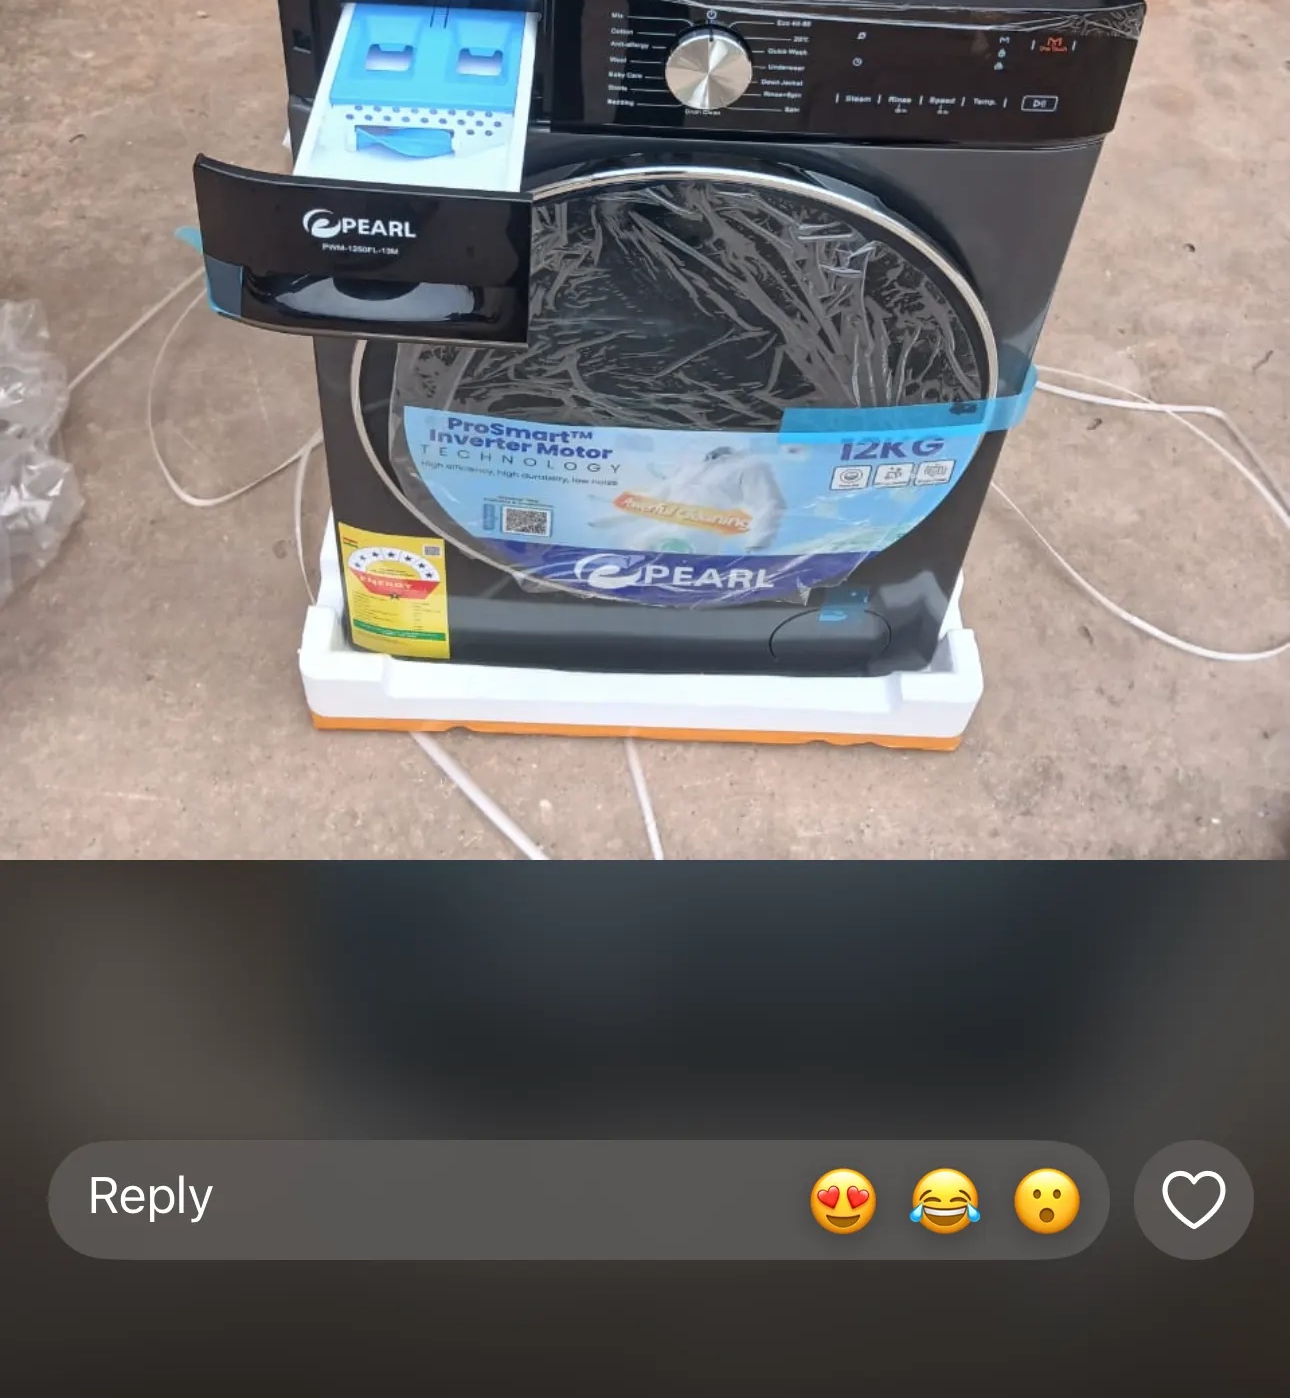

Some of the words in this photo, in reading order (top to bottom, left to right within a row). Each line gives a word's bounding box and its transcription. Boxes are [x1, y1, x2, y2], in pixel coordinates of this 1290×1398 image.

[788, 48, 808, 56] Wash
[608, 71, 626, 79] Baby
[845, 95, 872, 103] Steam
[929, 97, 956, 105] Speed
[342, 217, 417, 239] PEARL
[429, 429, 533, 453] Inverter
[536, 442, 614, 460] Motor
[840, 435, 945, 461] 12KG
[420, 444, 622, 474] TECHNOLOGY
[420, 460, 445, 471] High
[497, 469, 520, 479] high
[571, 477, 589, 485] low
[591, 479, 619, 487] noise
[645, 565, 774, 589] PEARL
